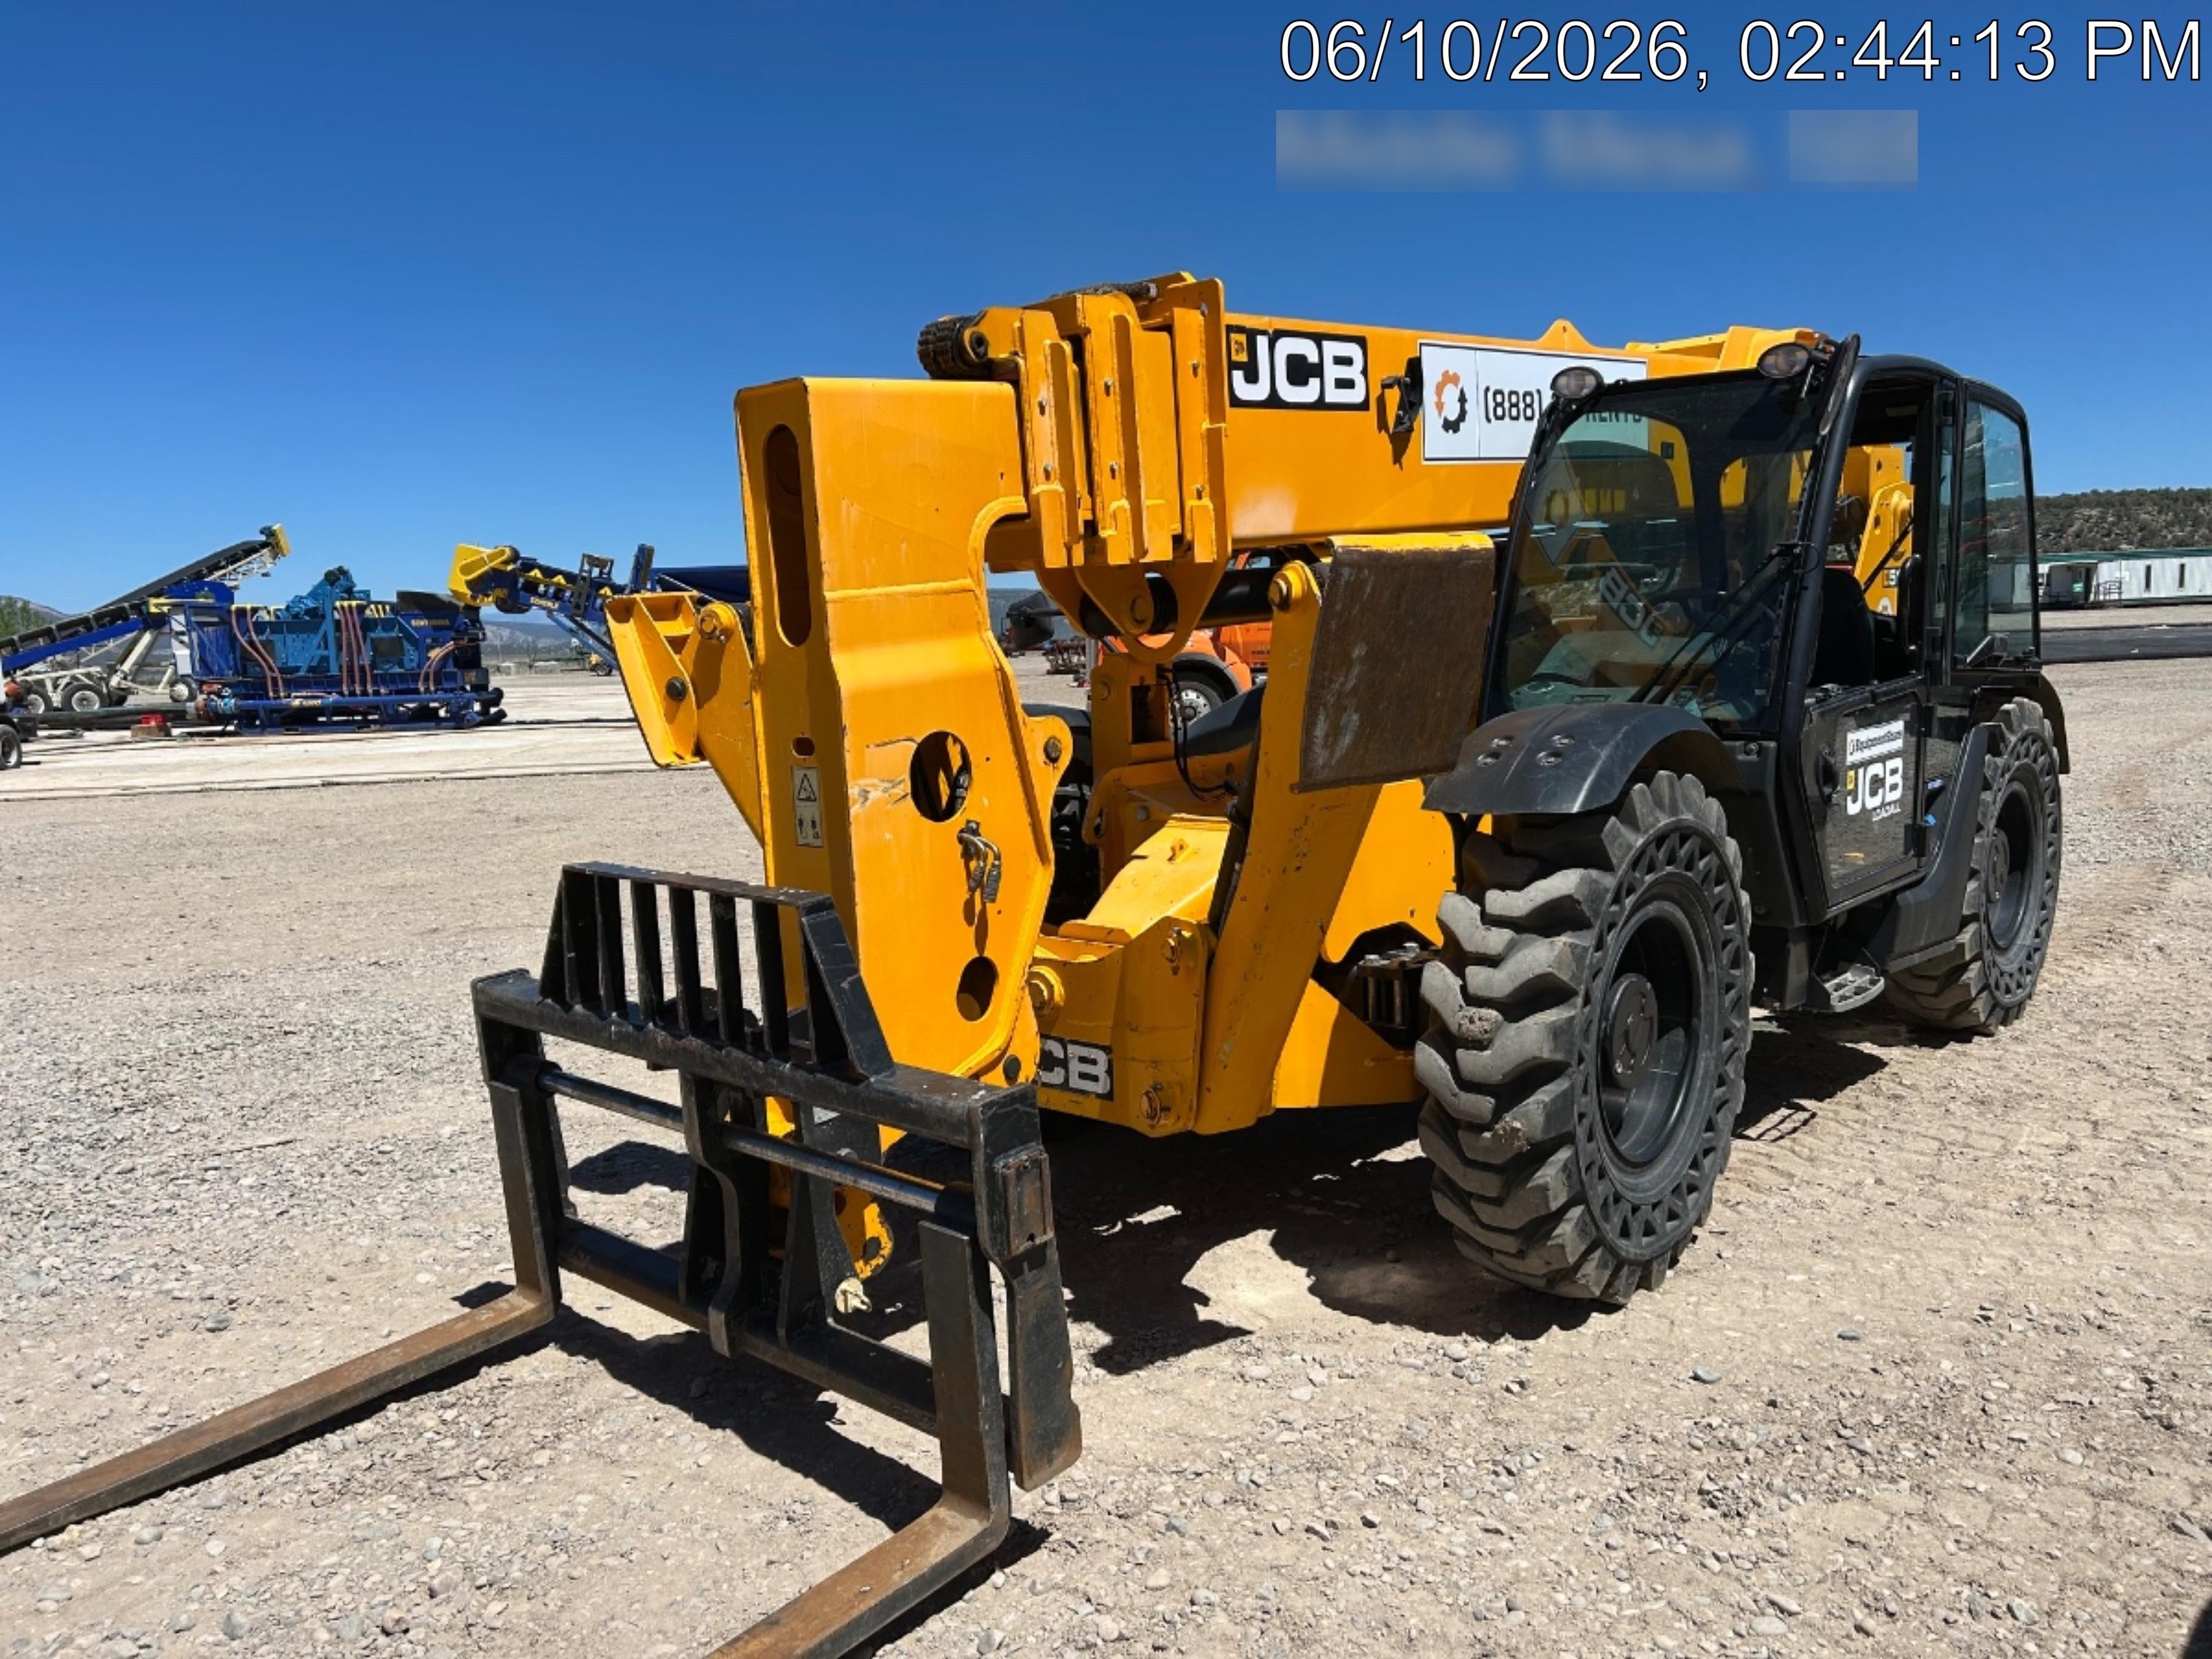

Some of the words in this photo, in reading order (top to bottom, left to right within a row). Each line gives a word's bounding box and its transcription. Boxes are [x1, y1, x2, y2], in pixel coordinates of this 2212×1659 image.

[1231, 335, 1367, 405] JCB
[1484, 385, 1542, 424] (888)
[1846, 757, 1903, 816] JCB
[1038, 1038, 1111, 1094] CB
